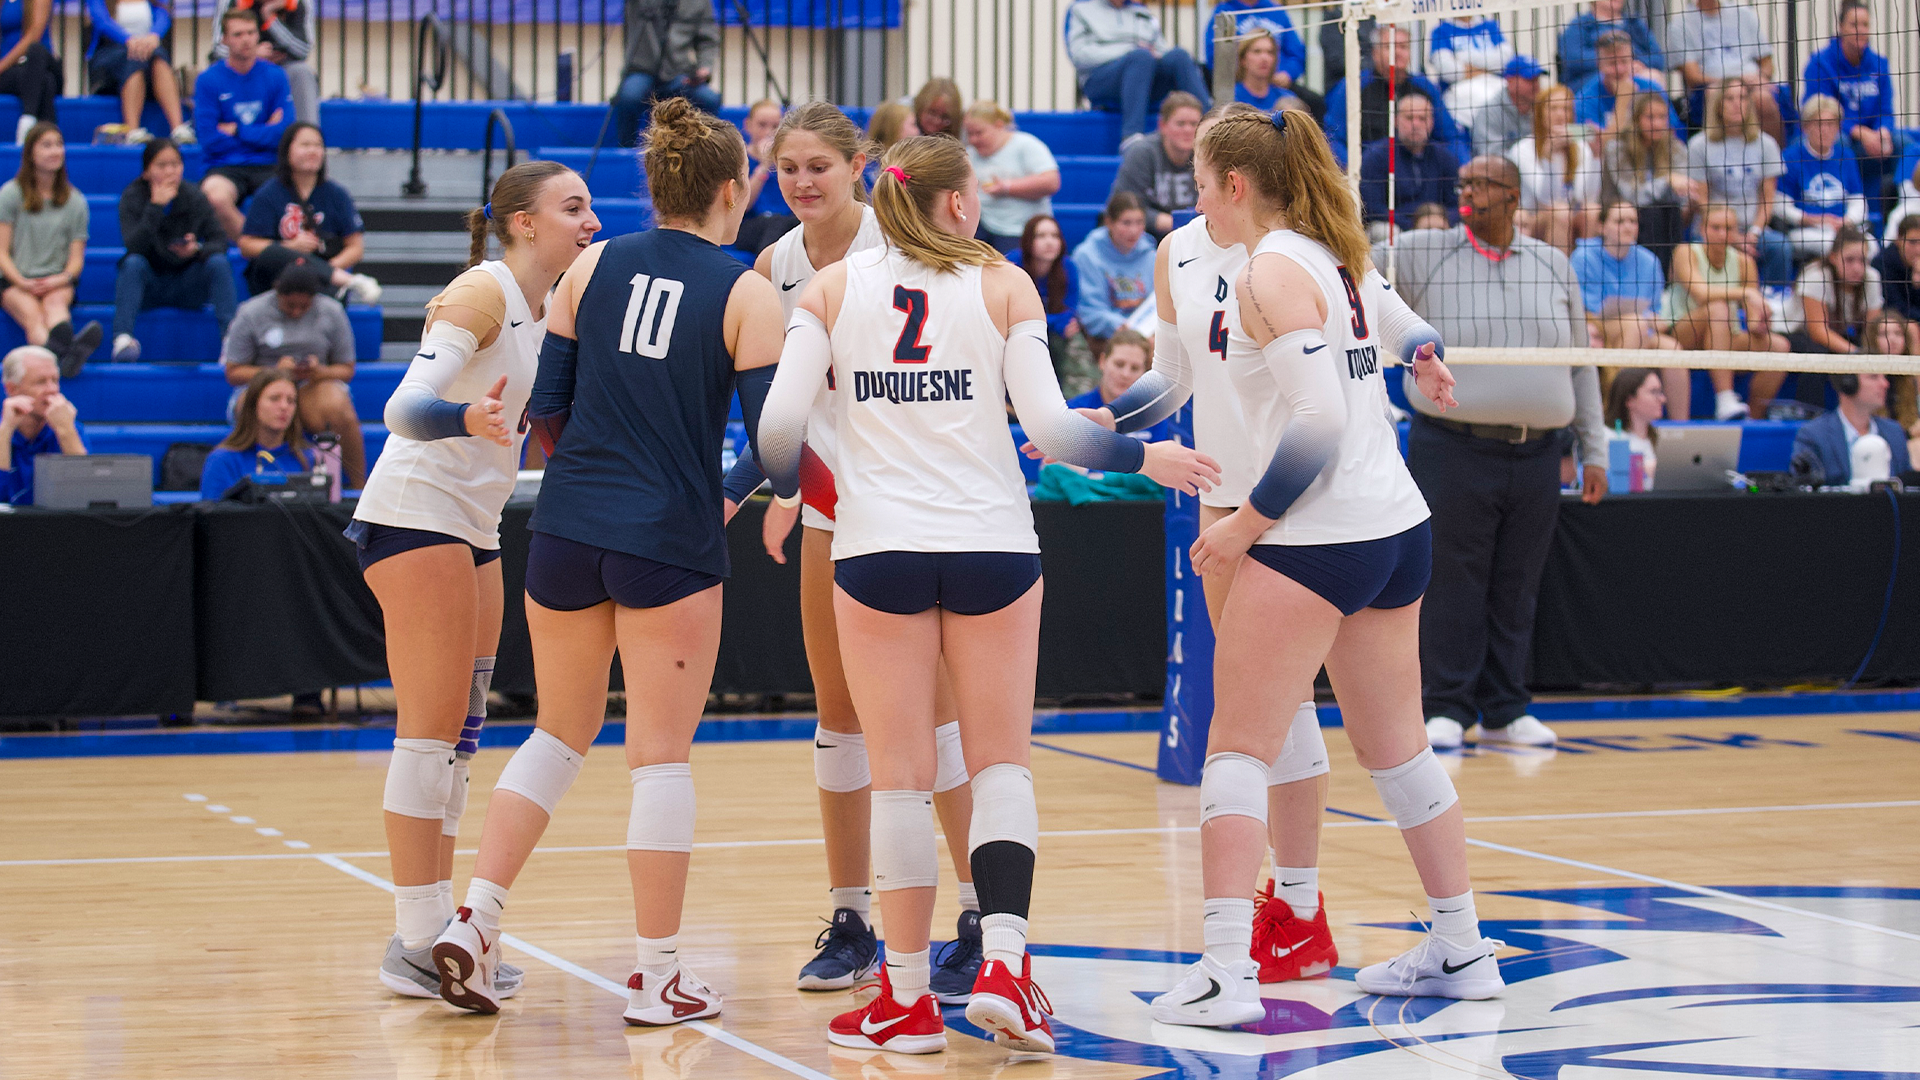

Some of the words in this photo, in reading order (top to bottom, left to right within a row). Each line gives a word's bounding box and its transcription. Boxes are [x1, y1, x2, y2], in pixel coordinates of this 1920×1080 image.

[618, 272, 685, 360] 10
[893, 283, 933, 364] 2
[1208, 310, 1229, 361] 4
[853, 369, 974, 404] DUQUESNE
